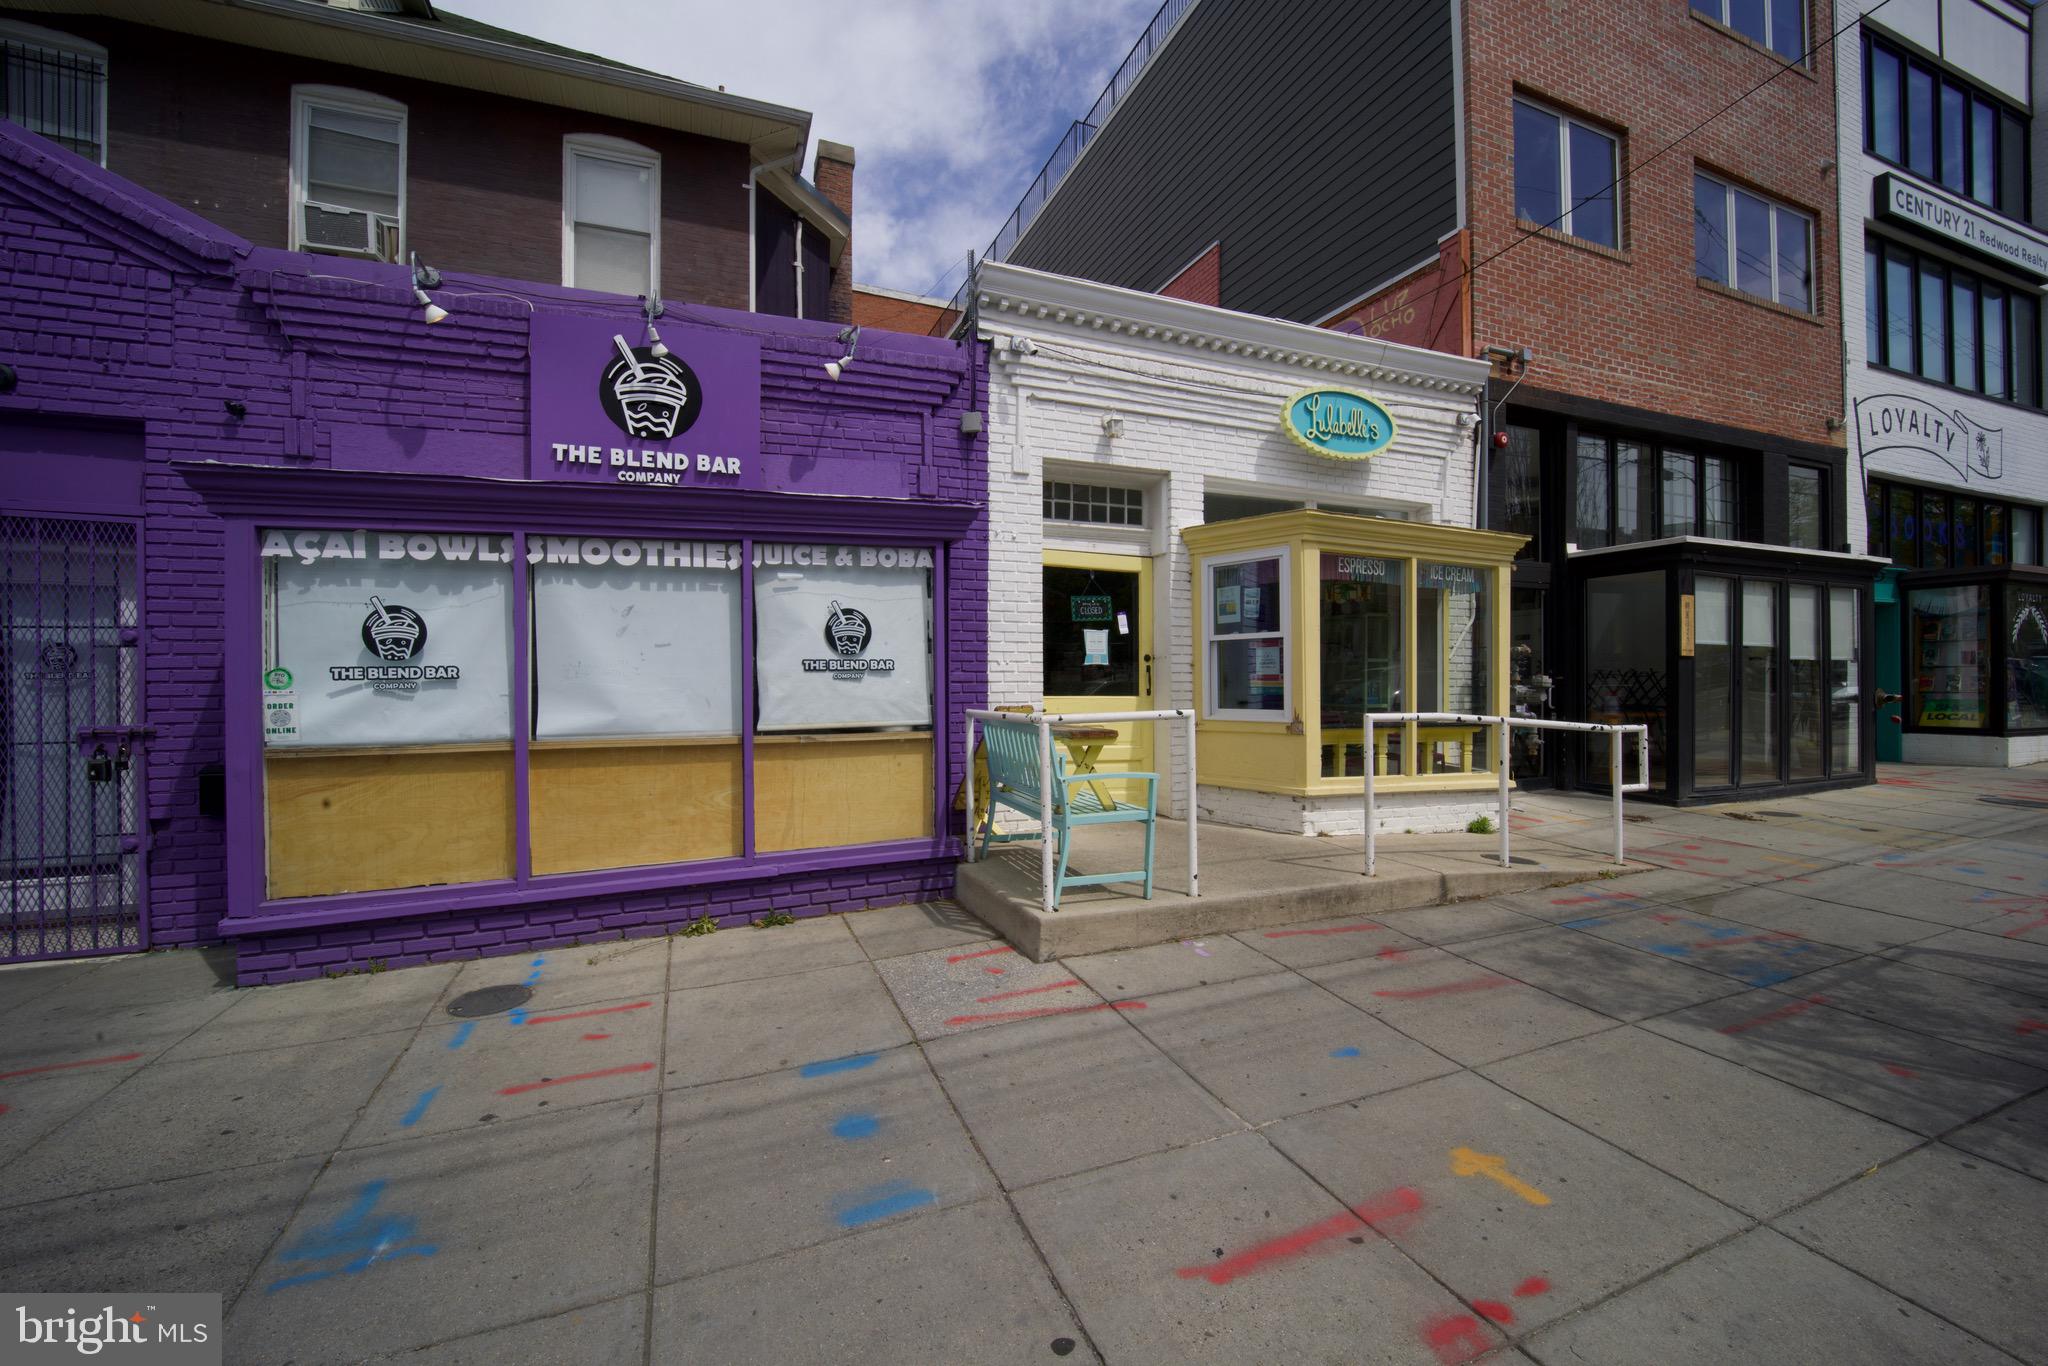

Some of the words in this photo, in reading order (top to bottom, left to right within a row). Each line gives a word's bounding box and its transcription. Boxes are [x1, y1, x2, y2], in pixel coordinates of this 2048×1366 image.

[1896, 189, 1961, 232] CENTURY
[1980, 230, 2019, 258] Redwood
[2022, 248, 2048, 272] Realty
[1305, 394, 1380, 440] Lulabelle's
[1868, 407, 1955, 452] LOYALTY
[552, 443, 602, 464] THE
[610, 448, 689, 471] BLEND
[696, 454, 741, 475] BAR
[617, 470, 681, 484] COMPANY
[378, 535, 515, 564] BOWLS
[526, 536, 742, 571] SMOOTHIES
[752, 543, 828, 568] JUICE
[834, 546, 852, 567] &
[860, 546, 935, 568] BOBA
[1338, 557, 1385, 576] ESPRESSO
[1430, 565, 1443, 581] ICE
[1445, 567, 1475, 583] CREAM
[1080, 606, 1103, 615] CLOSED
[802, 659, 828, 671] THE
[828, 659, 869, 671] BLEND
[868, 659, 894, 671] BAR
[330, 666, 365, 680] THE
[366, 666, 423, 680] BLEND
[424, 666, 460, 680] BAR
[833, 672, 865, 680] COMPANY
[373, 681, 417, 690] COMPANY
[1926, 712, 1977, 721] LOCAL
[266, 727, 297, 735] ONLINE
